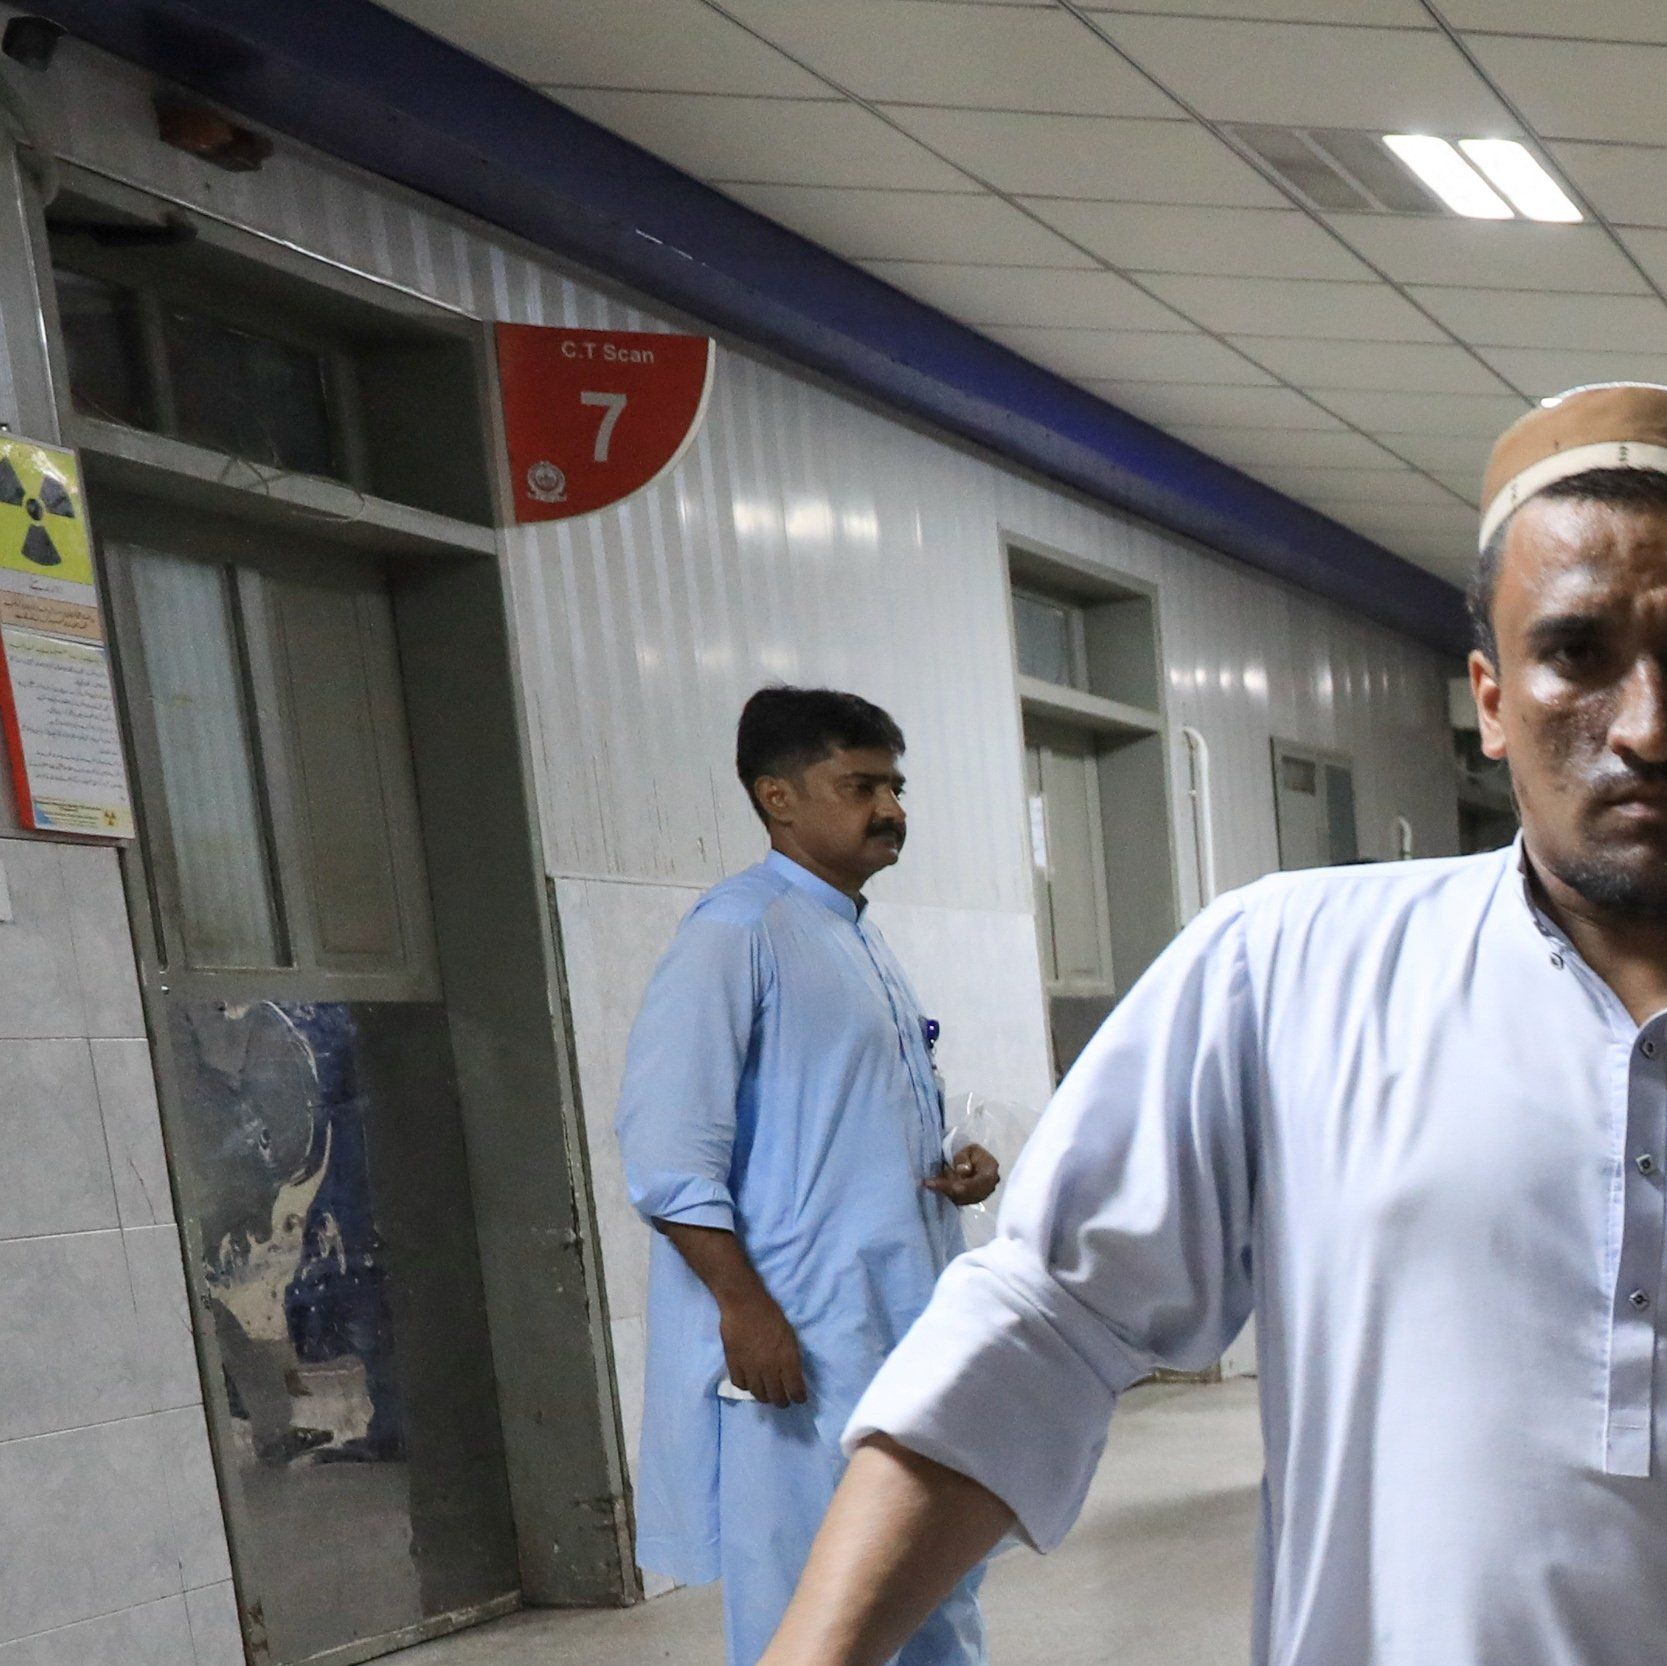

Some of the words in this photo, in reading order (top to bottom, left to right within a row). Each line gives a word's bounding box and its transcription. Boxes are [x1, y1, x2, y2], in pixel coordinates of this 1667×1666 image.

[560, 340, 597, 359] C.T
[603, 343, 655, 363] Scan
[580, 390, 628, 463] 7
